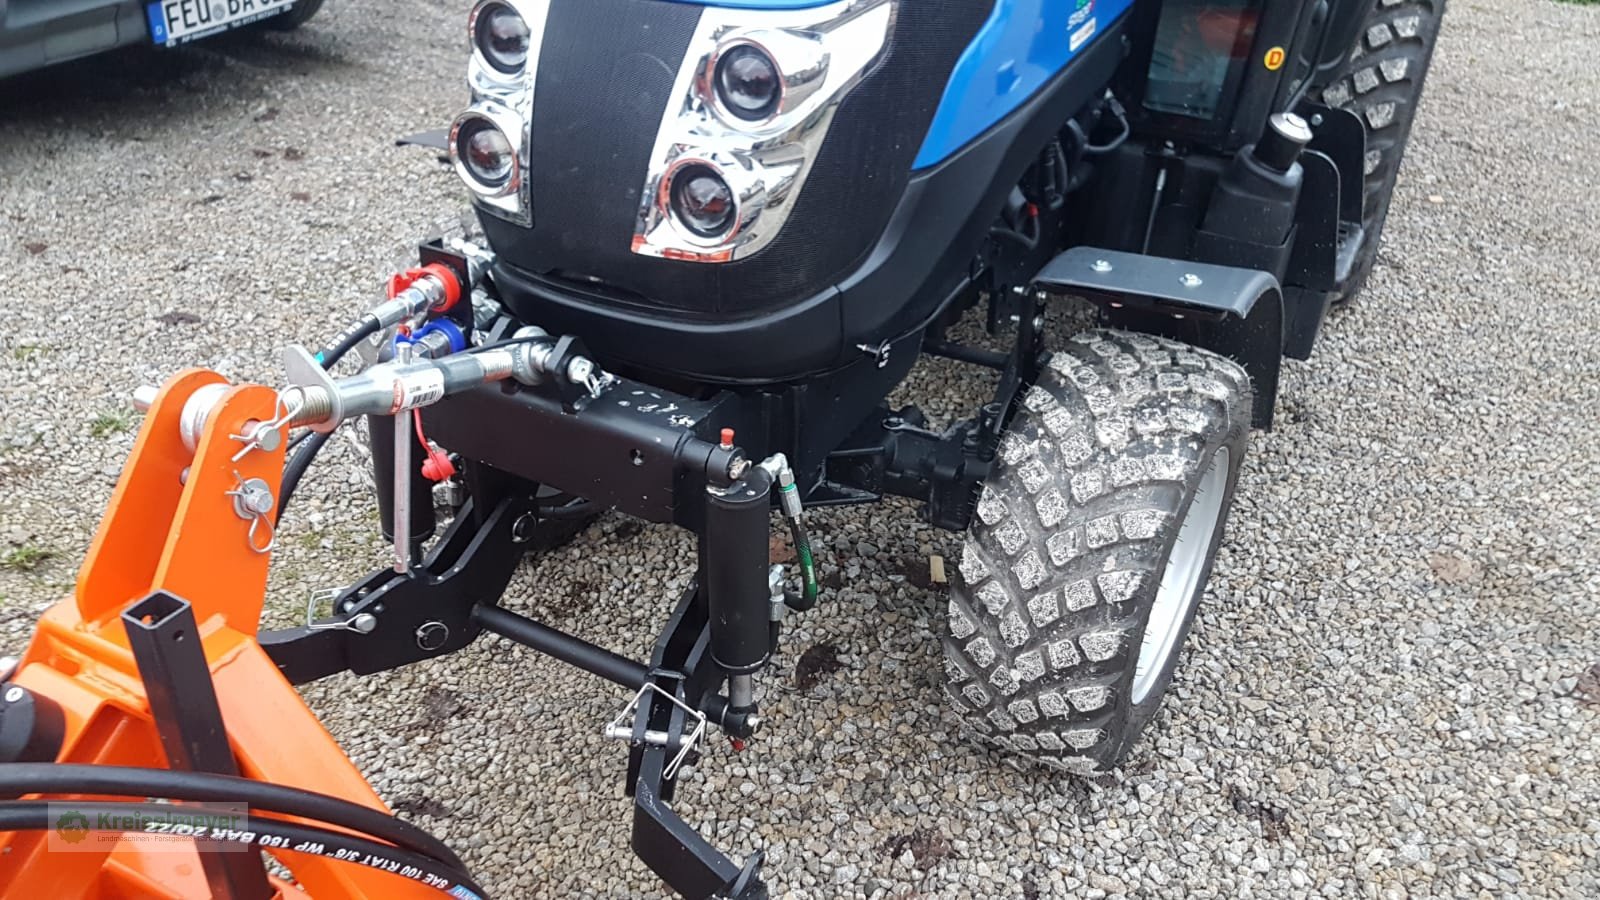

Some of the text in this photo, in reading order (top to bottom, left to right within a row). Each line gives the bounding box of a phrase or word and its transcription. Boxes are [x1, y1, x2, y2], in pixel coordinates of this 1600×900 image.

[165, 0, 211, 33] FEU
[1269, 51, 1282, 65] D
[210, 828, 256, 843] BAR
[258, 834, 290, 848] 180
[294, 841, 324, 855] WP
[360, 854, 401, 872] R1AT
[399, 865, 423, 879] 100
[422, 873, 449, 889] SAE
